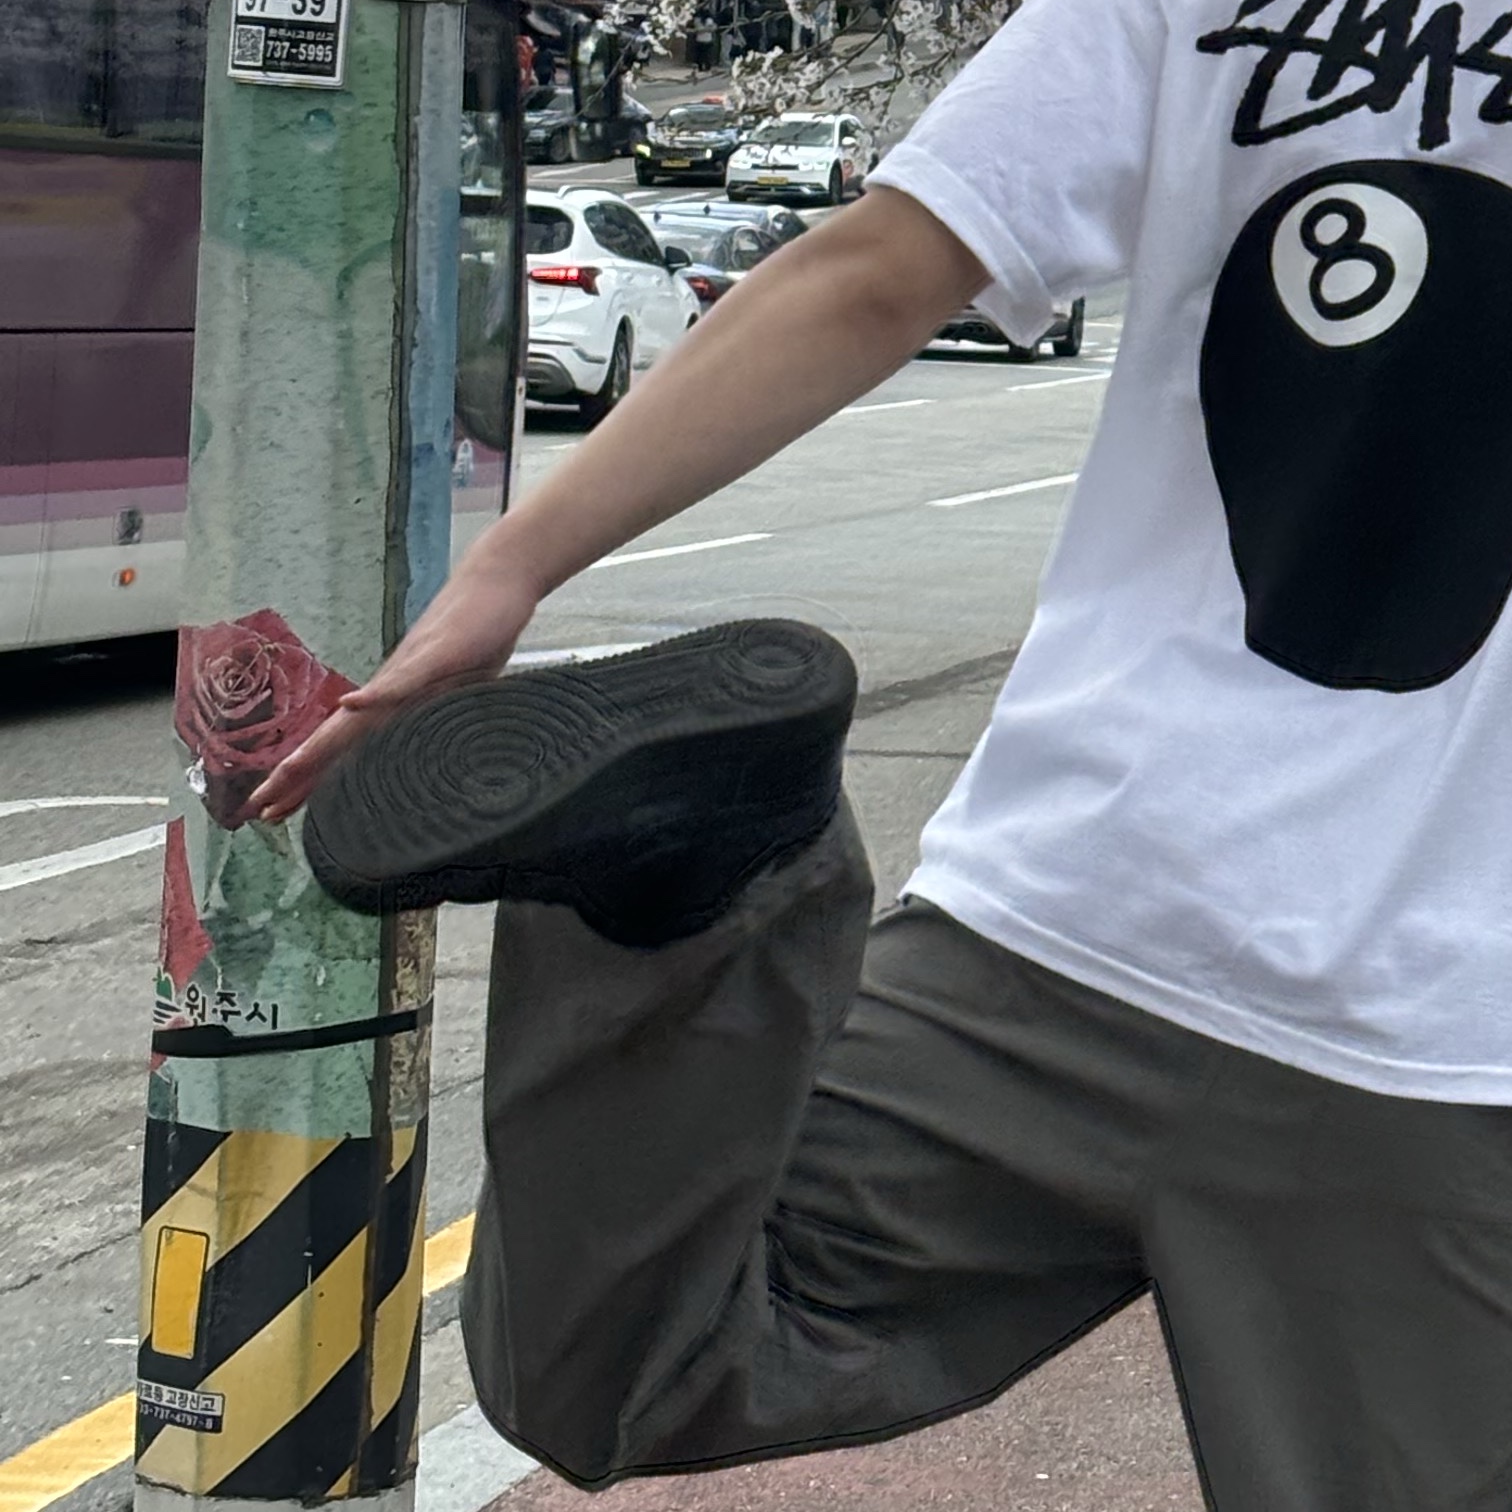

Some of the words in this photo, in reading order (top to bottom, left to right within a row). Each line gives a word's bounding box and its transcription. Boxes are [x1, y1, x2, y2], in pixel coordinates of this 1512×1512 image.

[266, 40, 333, 62] 737-5995
[1300, 197, 1395, 321] 8
[185, 983, 278, 1030] 원주시
[165, 1389, 216, 1412] 고장신고
